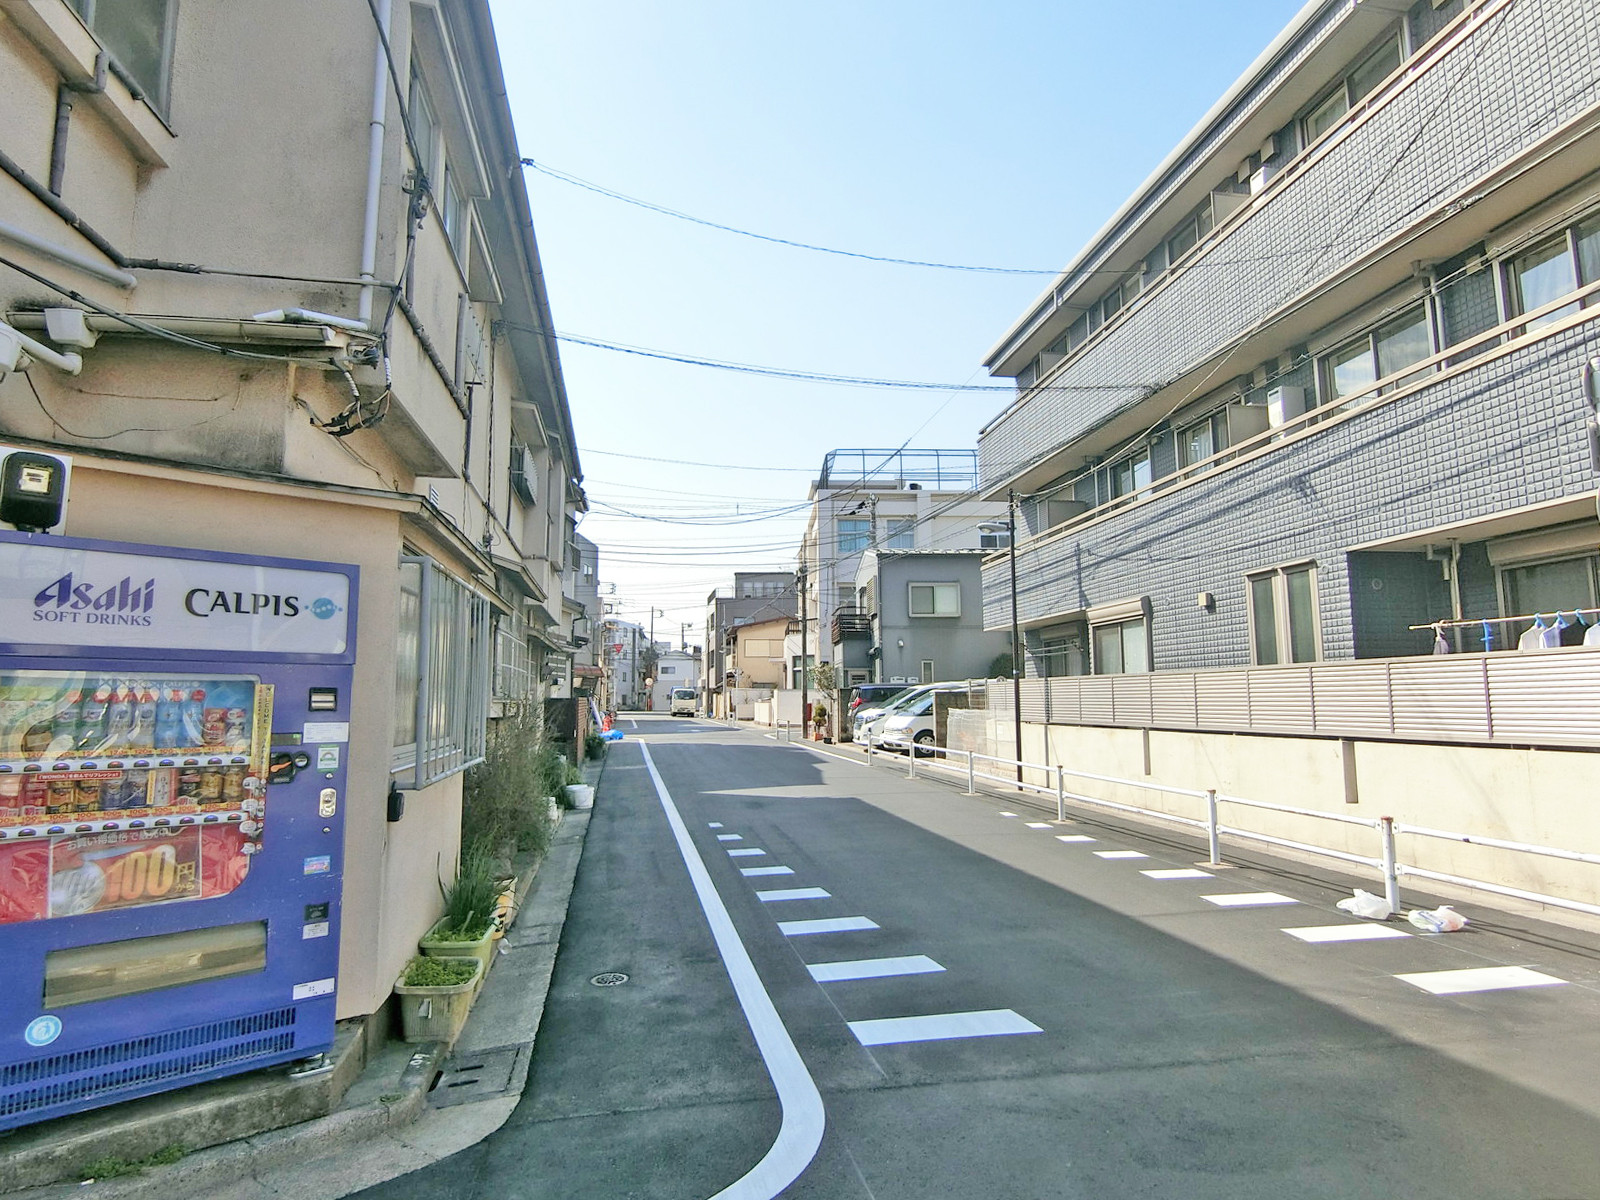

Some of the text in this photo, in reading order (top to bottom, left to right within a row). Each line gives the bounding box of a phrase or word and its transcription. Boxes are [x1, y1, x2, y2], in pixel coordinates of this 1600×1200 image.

[34, 571, 155, 614] Asahi
[184, 588, 300, 618] CALPIS
[32, 609, 152, 627] SOFT DRINKS
